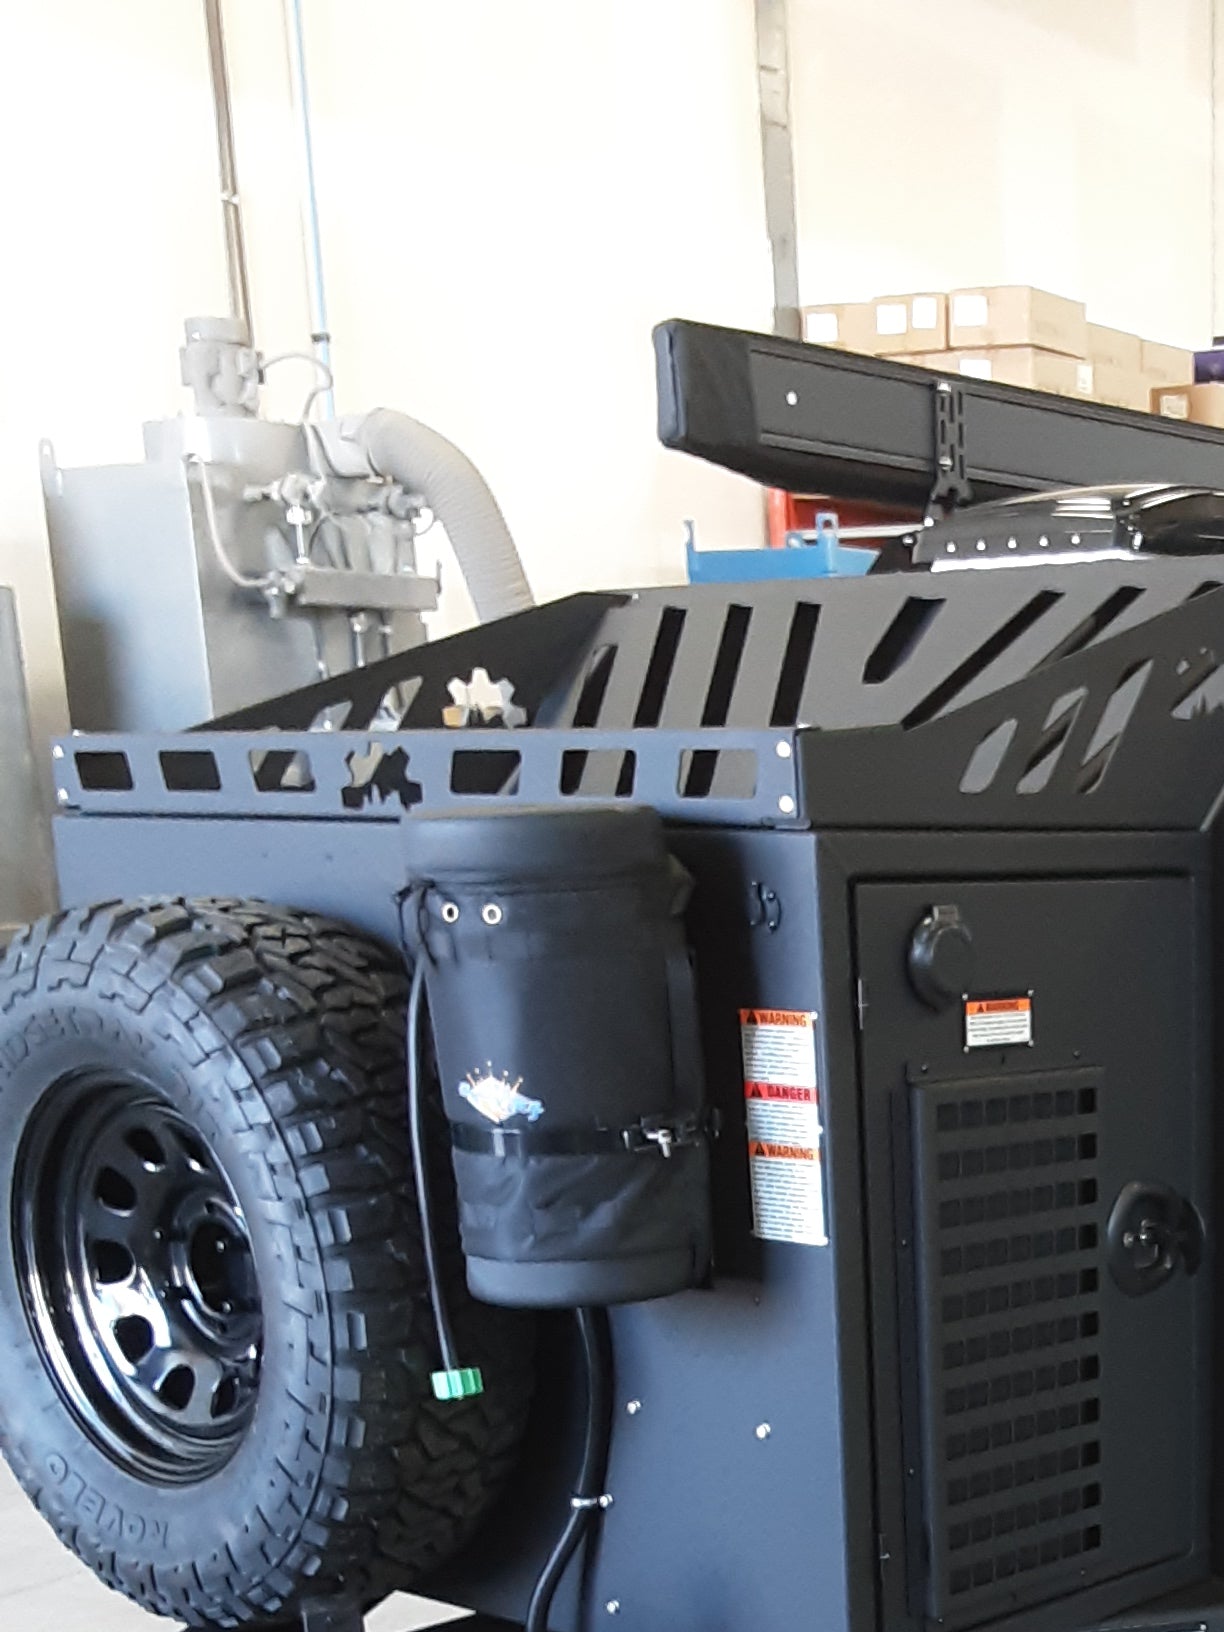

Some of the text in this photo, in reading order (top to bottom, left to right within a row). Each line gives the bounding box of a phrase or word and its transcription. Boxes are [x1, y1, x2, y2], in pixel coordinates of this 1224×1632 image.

[759, 1012, 808, 1027] WARNING
[766, 1084, 811, 1101] DANGER
[767, 1144, 815, 1160] WARNING
